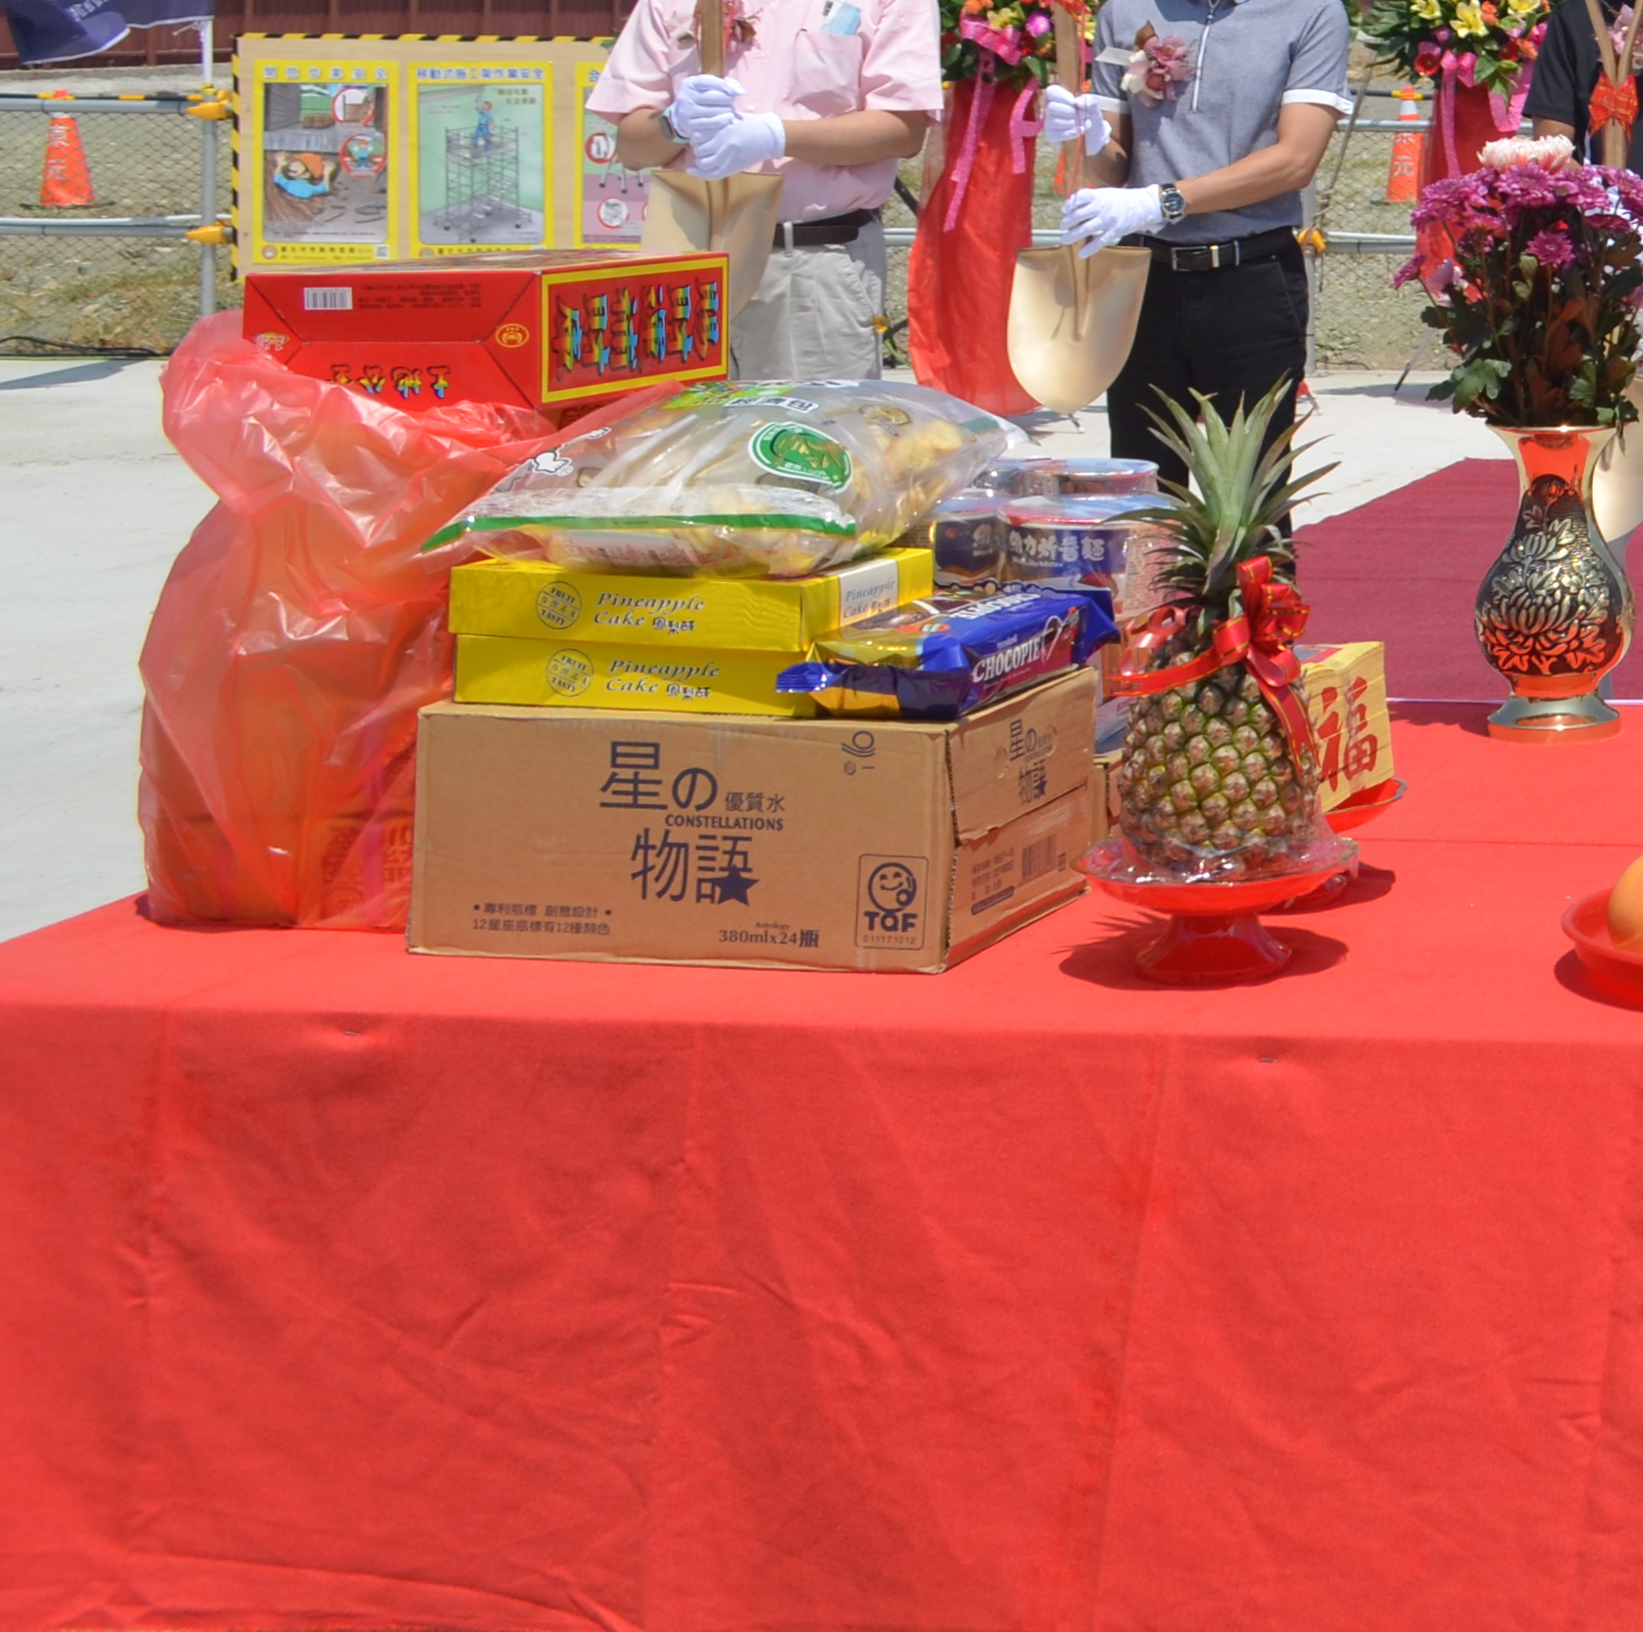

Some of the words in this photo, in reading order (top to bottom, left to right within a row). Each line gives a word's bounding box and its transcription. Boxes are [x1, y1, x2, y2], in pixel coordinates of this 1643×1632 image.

[845, 576, 896, 602] Pineapple
[596, 592, 705, 616] Pineapple
[594, 610, 645, 627] Cake
[608, 658, 721, 683] Pineapple
[972, 635, 1042, 684] CHOCOPIE
[605, 678, 660, 694] Cake
[1316, 676, 1378, 793] 福
[599, 740, 720, 813] 星の
[724, 791, 787, 814] 優質水
[664, 813, 785, 832] CONSTELLATIONS
[629, 826, 757, 906] 物語
[482, 901, 538, 918] 專利瓶標
[544, 904, 600, 920] 創意設計
